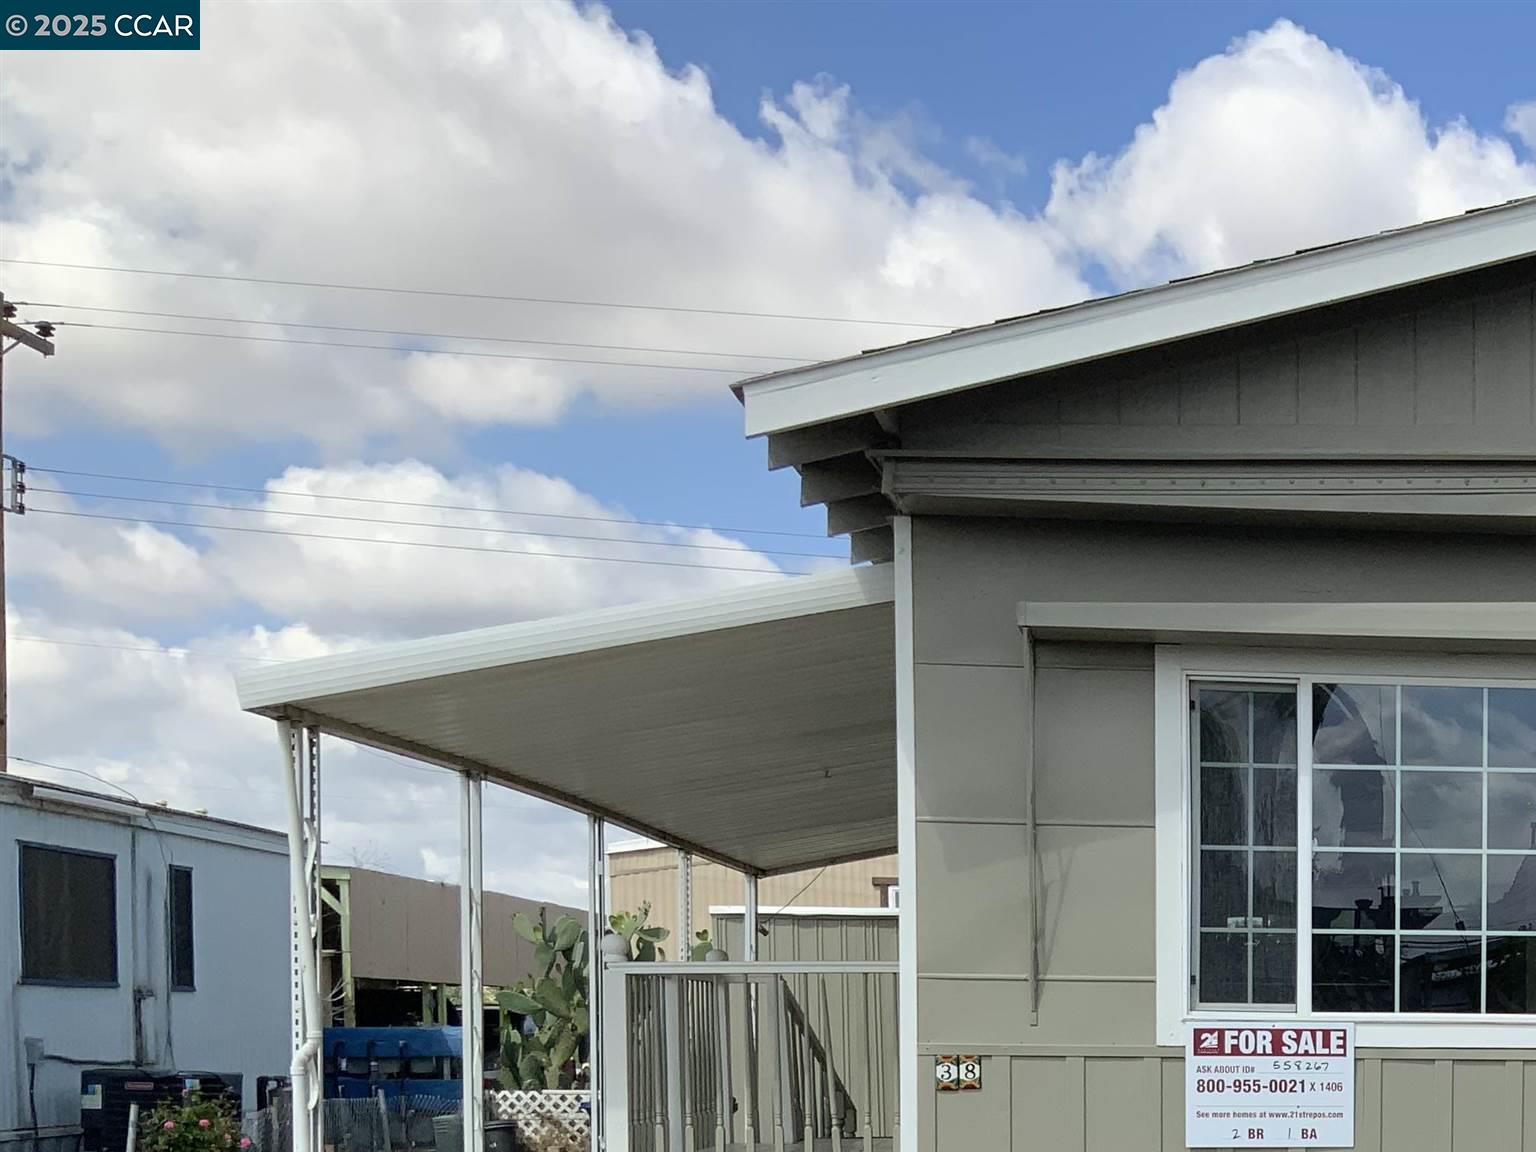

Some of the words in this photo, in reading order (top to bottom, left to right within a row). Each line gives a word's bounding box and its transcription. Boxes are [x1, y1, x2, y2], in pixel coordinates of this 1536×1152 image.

[1224, 1030, 1273, 1054] FOR
[1281, 1030, 1345, 1055] SALE
[940, 1063, 976, 1081] 38
[1196, 1065, 1212, 1073] ASK
[1214, 1065, 1240, 1073] ABOUT
[1242, 1065, 1255, 1074] ID#
[1196, 1079, 1305, 1093] 800-955-0021
[1309, 1082, 1316, 1092] X
[1320, 1082, 1343, 1092] 1406
[1196, 1110, 1210, 1118] See
[1233, 1110, 1257, 1118] homes
[1259, 1110, 1267, 1118] at
[1248, 1128, 1264, 1139] BR
[1301, 1128, 1318, 1139] BA
